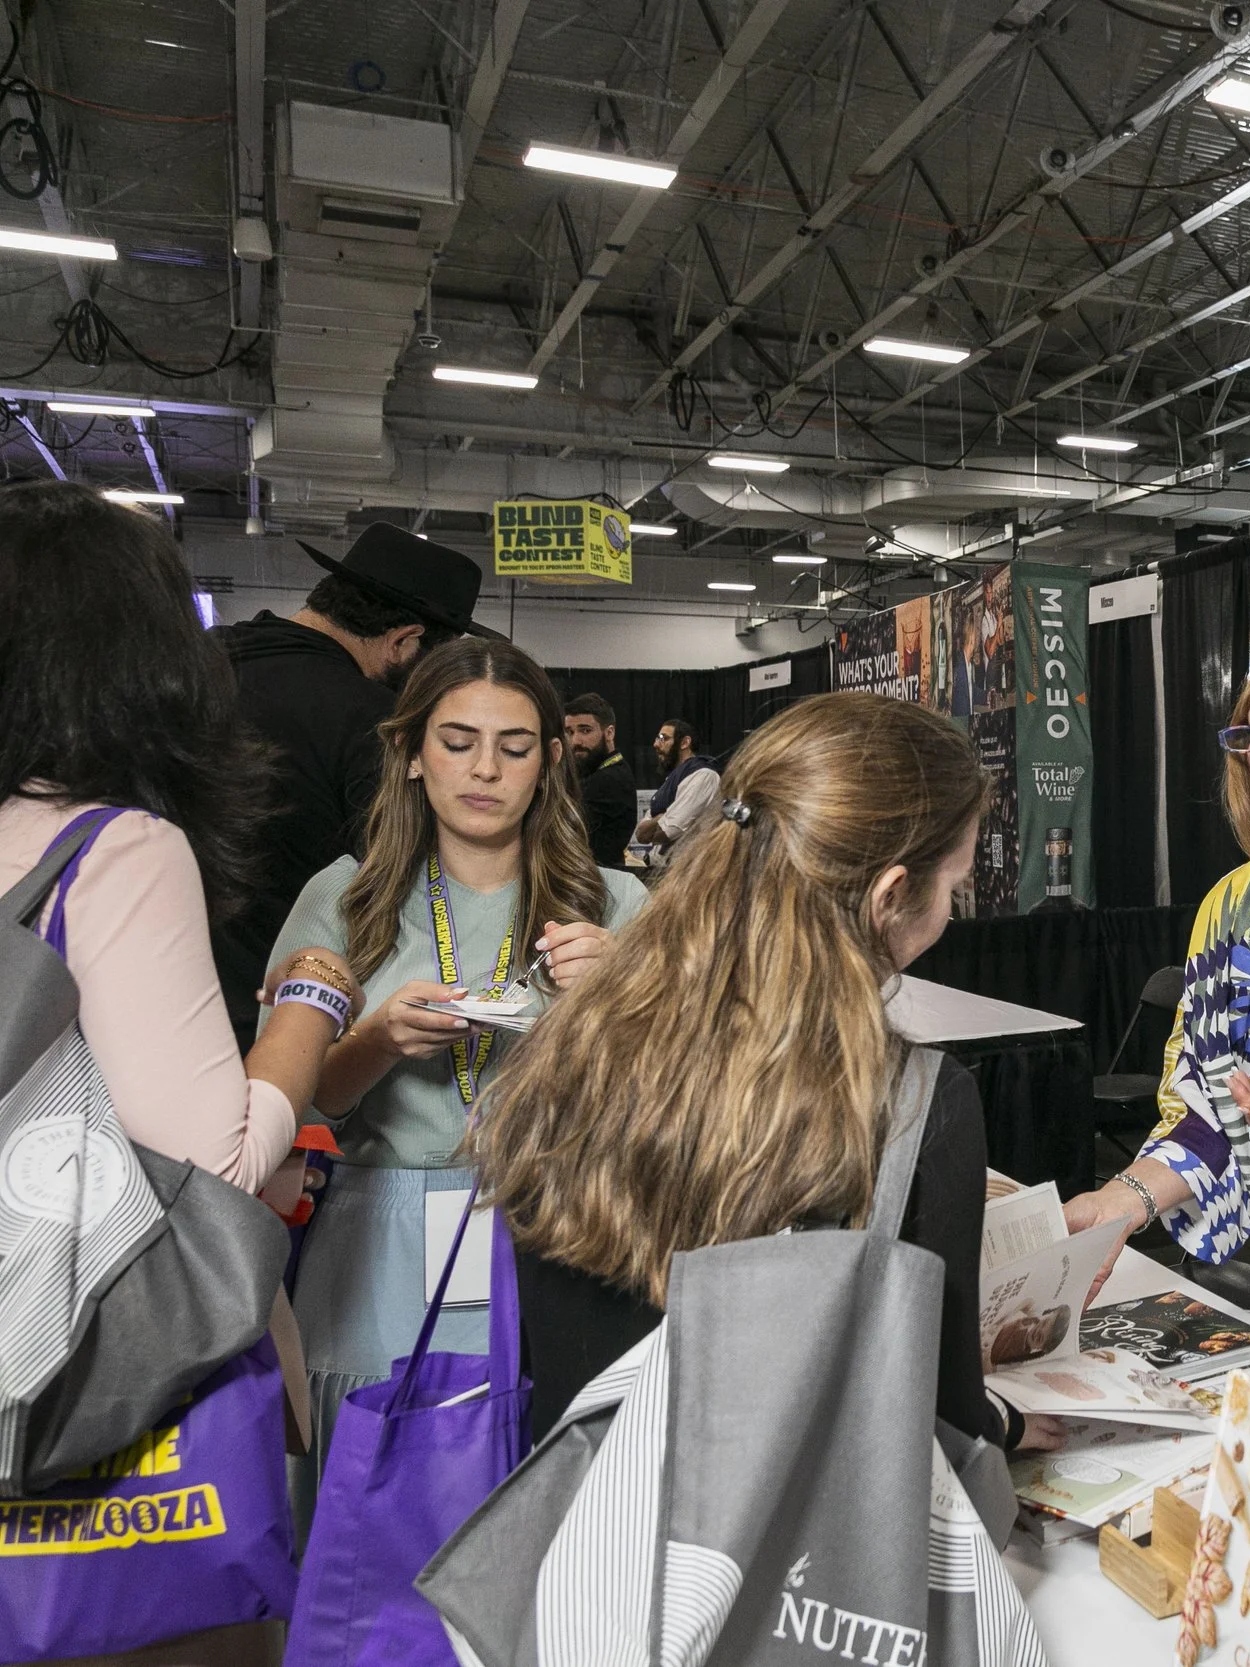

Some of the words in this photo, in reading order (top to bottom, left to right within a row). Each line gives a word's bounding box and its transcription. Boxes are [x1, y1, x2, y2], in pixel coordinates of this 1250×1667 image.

[498, 505, 583, 526] BLIND
[498, 528, 584, 547] TASTE
[499, 549, 584, 561] CONTEST
[590, 562, 611, 573] CONTEST
[838, 657, 873, 685] WHAT'S
[874, 651, 899, 678] YOUR
[1032, 767, 1069, 781] Total
[1036, 782, 1075, 796] Wine
[432, 897, 459, 984] KOSHERPALOOZA
[281, 983, 317, 998] GOT
